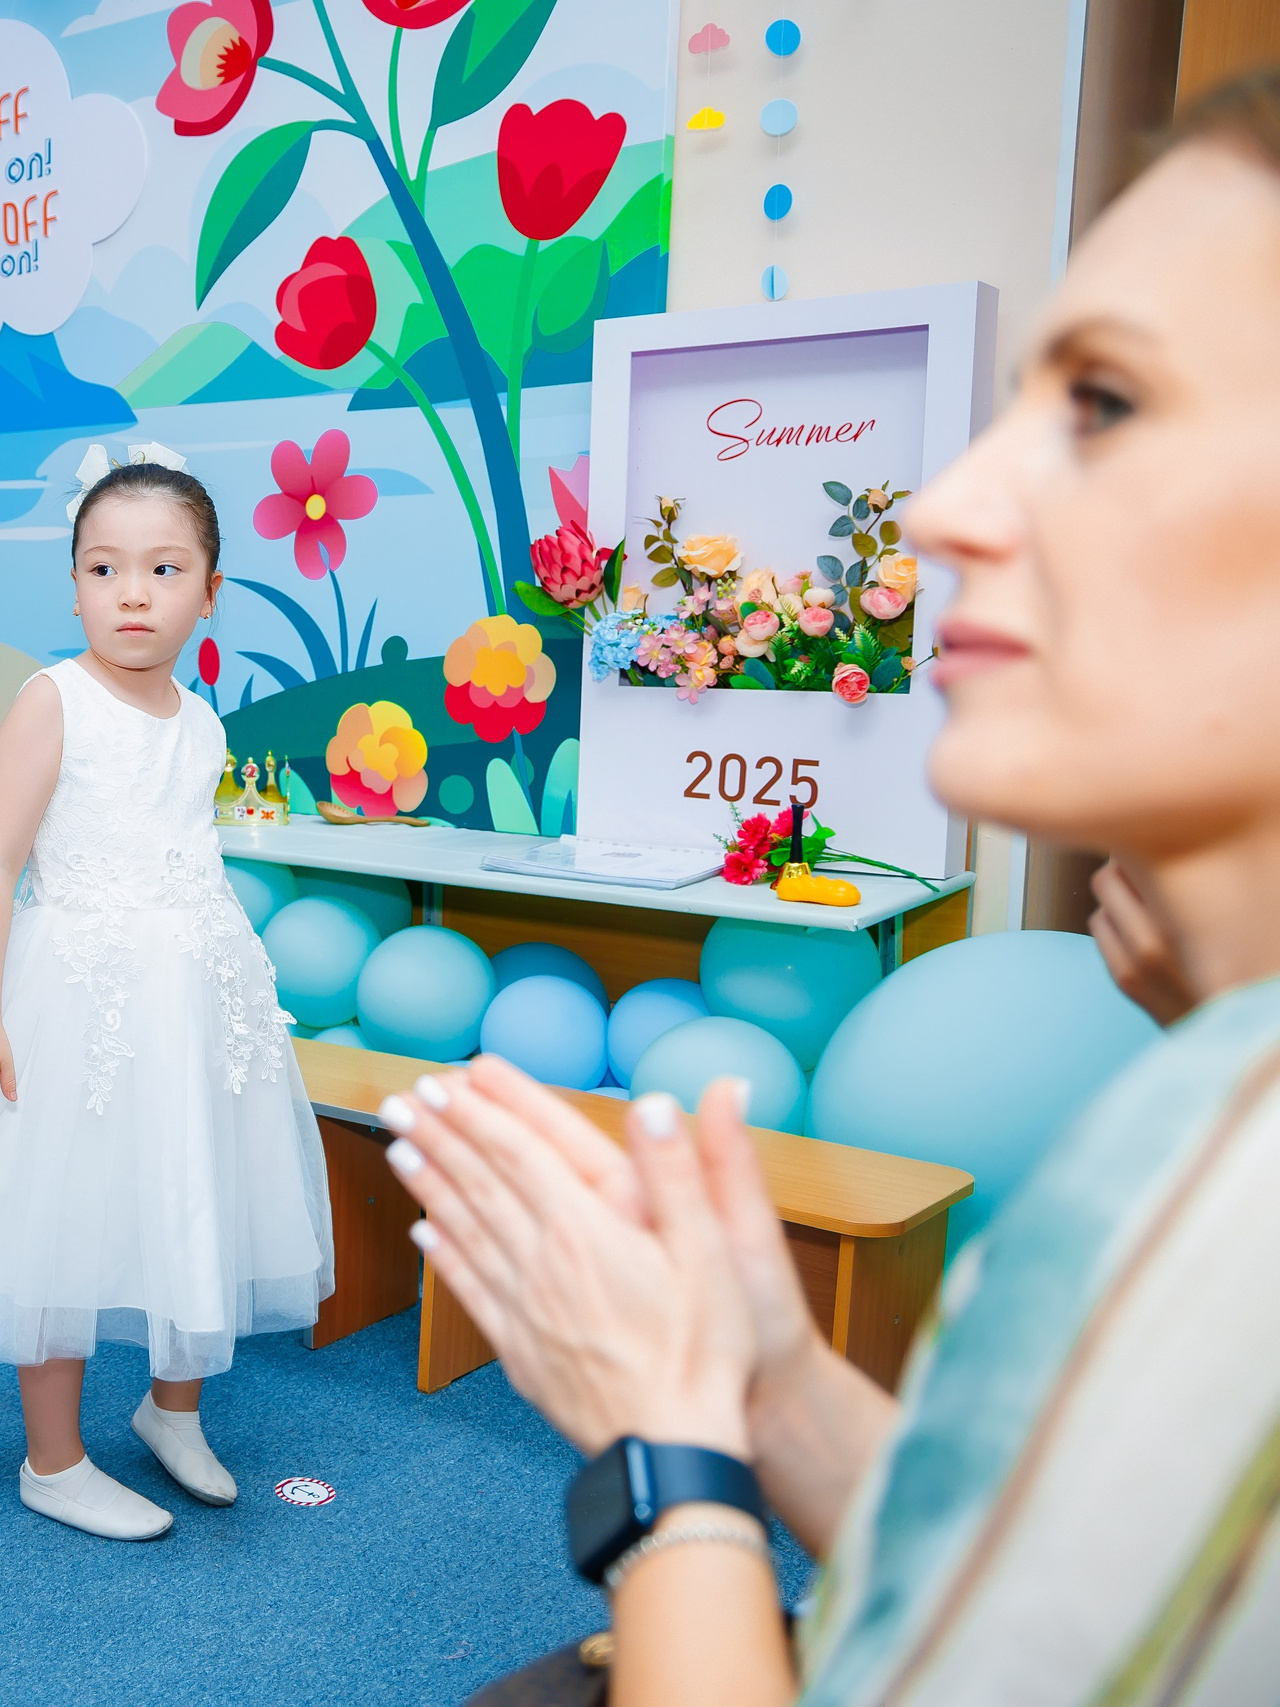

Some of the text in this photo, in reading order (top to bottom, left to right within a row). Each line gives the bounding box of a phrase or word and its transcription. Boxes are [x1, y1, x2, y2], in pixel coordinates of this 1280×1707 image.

[3, 189, 59, 245] OFF
[706, 398, 876, 461] Summer
[683, 750, 820, 809] 2025
